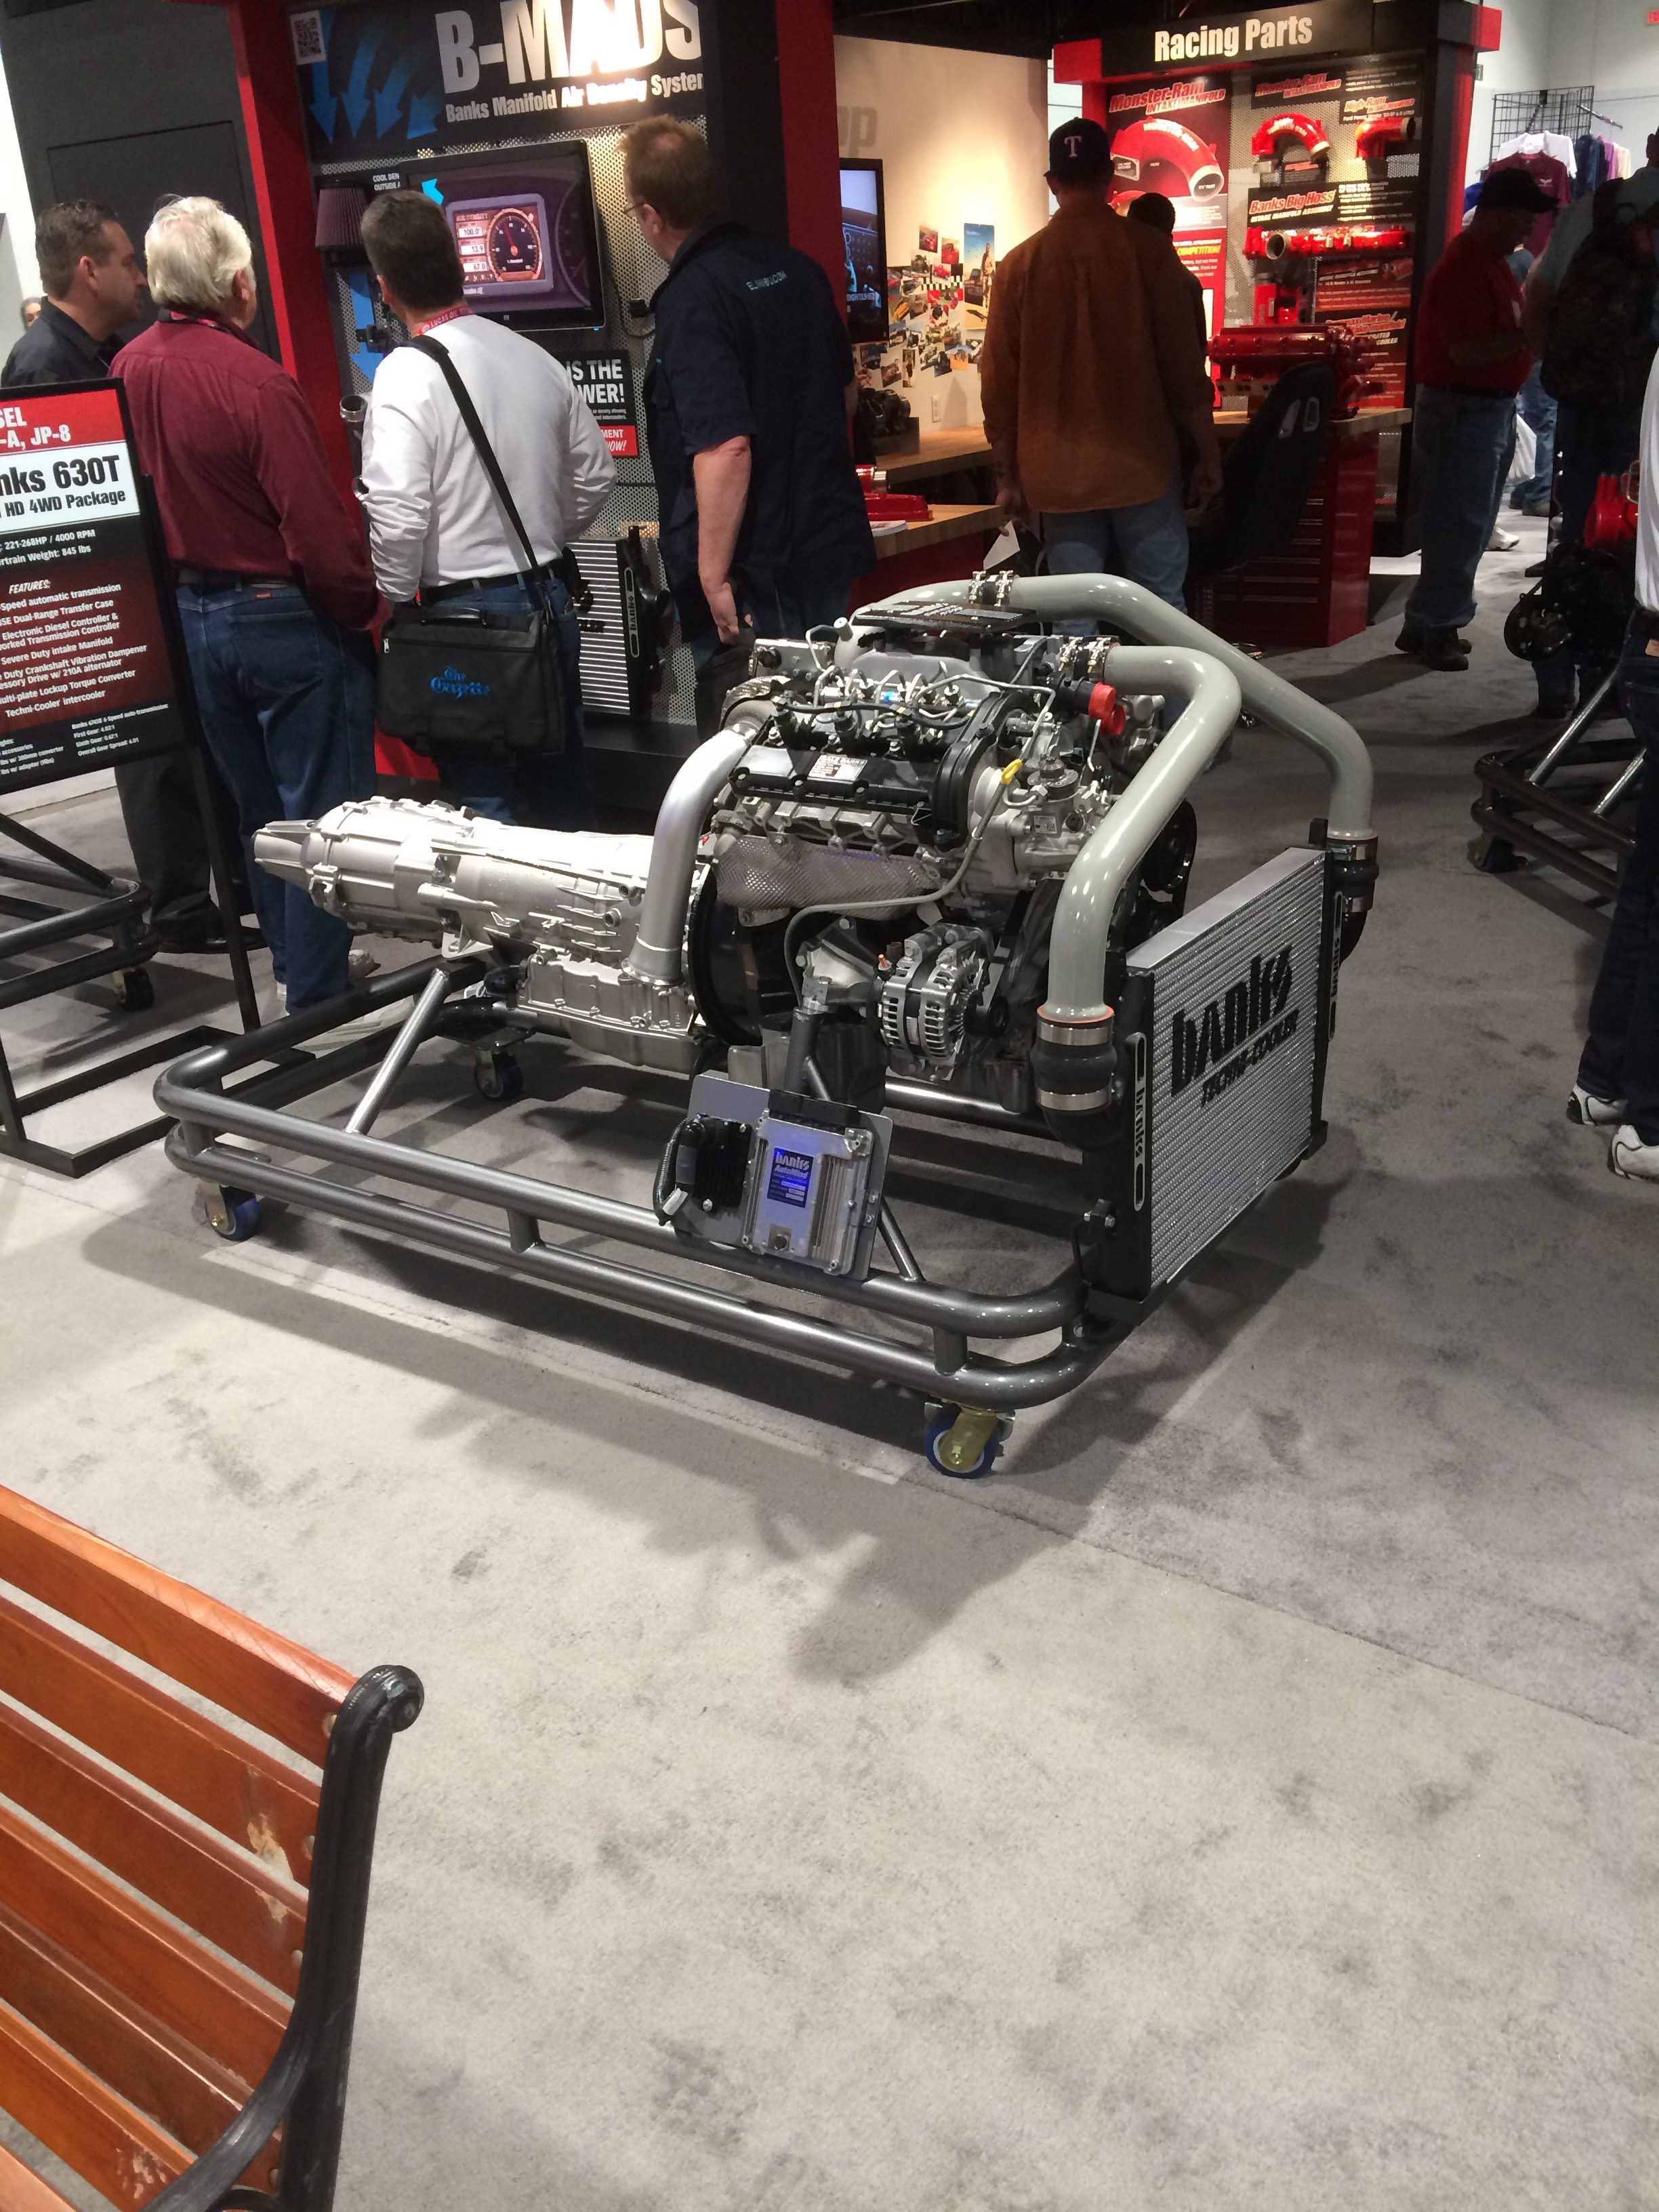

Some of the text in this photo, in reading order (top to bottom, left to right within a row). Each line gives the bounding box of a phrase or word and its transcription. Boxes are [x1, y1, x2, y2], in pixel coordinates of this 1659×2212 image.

[435, 0, 701, 94] B-MADS
[1154, 16, 1313, 62] Racing Parts
[446, 101, 489, 123] Banks
[493, 89, 557, 116] Manifold
[561, 87, 585, 108] Air
[586, 77, 647, 104] Density
[1109, 82, 1205, 113] Monster-Ram
[1064, 136, 1082, 157] T
[373, 174, 388, 182] COOL
[374, 182, 397, 190] OUTSIDE
[1249, 190, 1336, 215] Banks Big Hoss
[430, 310, 458, 328] LUCAS OIL
[586, 359, 623, 380] THE
[30, 424, 71, 445] JP-8
[53, 455, 120, 489] 630T
[4, 490, 127, 517] HD 4WD Package
[4, 529, 96, 550] 221-268HP / 4000 RPM
[27, 549, 60, 561] Weight:
[62, 546, 77, 556] 845
[78, 545, 91, 554] lbs
[9, 579, 51, 594] FEATURES:
[28, 592, 69, 606] automatic
[70, 584, 121, 599] transmission
[14, 609, 59, 624] Dual-Range
[60, 602, 94, 615] Transfer
[94, 600, 114, 609] Case
[2, 612, 119, 640] Electronic Diesel Controller &
[26, 629, 81, 646] Transmission
[81, 621, 120, 635] Controller
[1, 653, 30, 665] Severe
[30, 649, 50, 660] Duty
[79, 636, 113, 650] Manifold
[3, 669, 24, 680] Duty
[25, 659, 70, 675] Crankshaft
[70, 653, 107, 666] Vibration
[108, 644, 147, 659] Dampener
[27, 673, 49, 684] Drive
[62, 666, 83, 677] 210A
[83, 658, 122, 672] alternator
[39, 684, 68, 696] Lockup
[68, 678, 97, 690] Torque
[98, 670, 136, 684] Converter
[5, 699, 60, 718] Techni-Cooler
